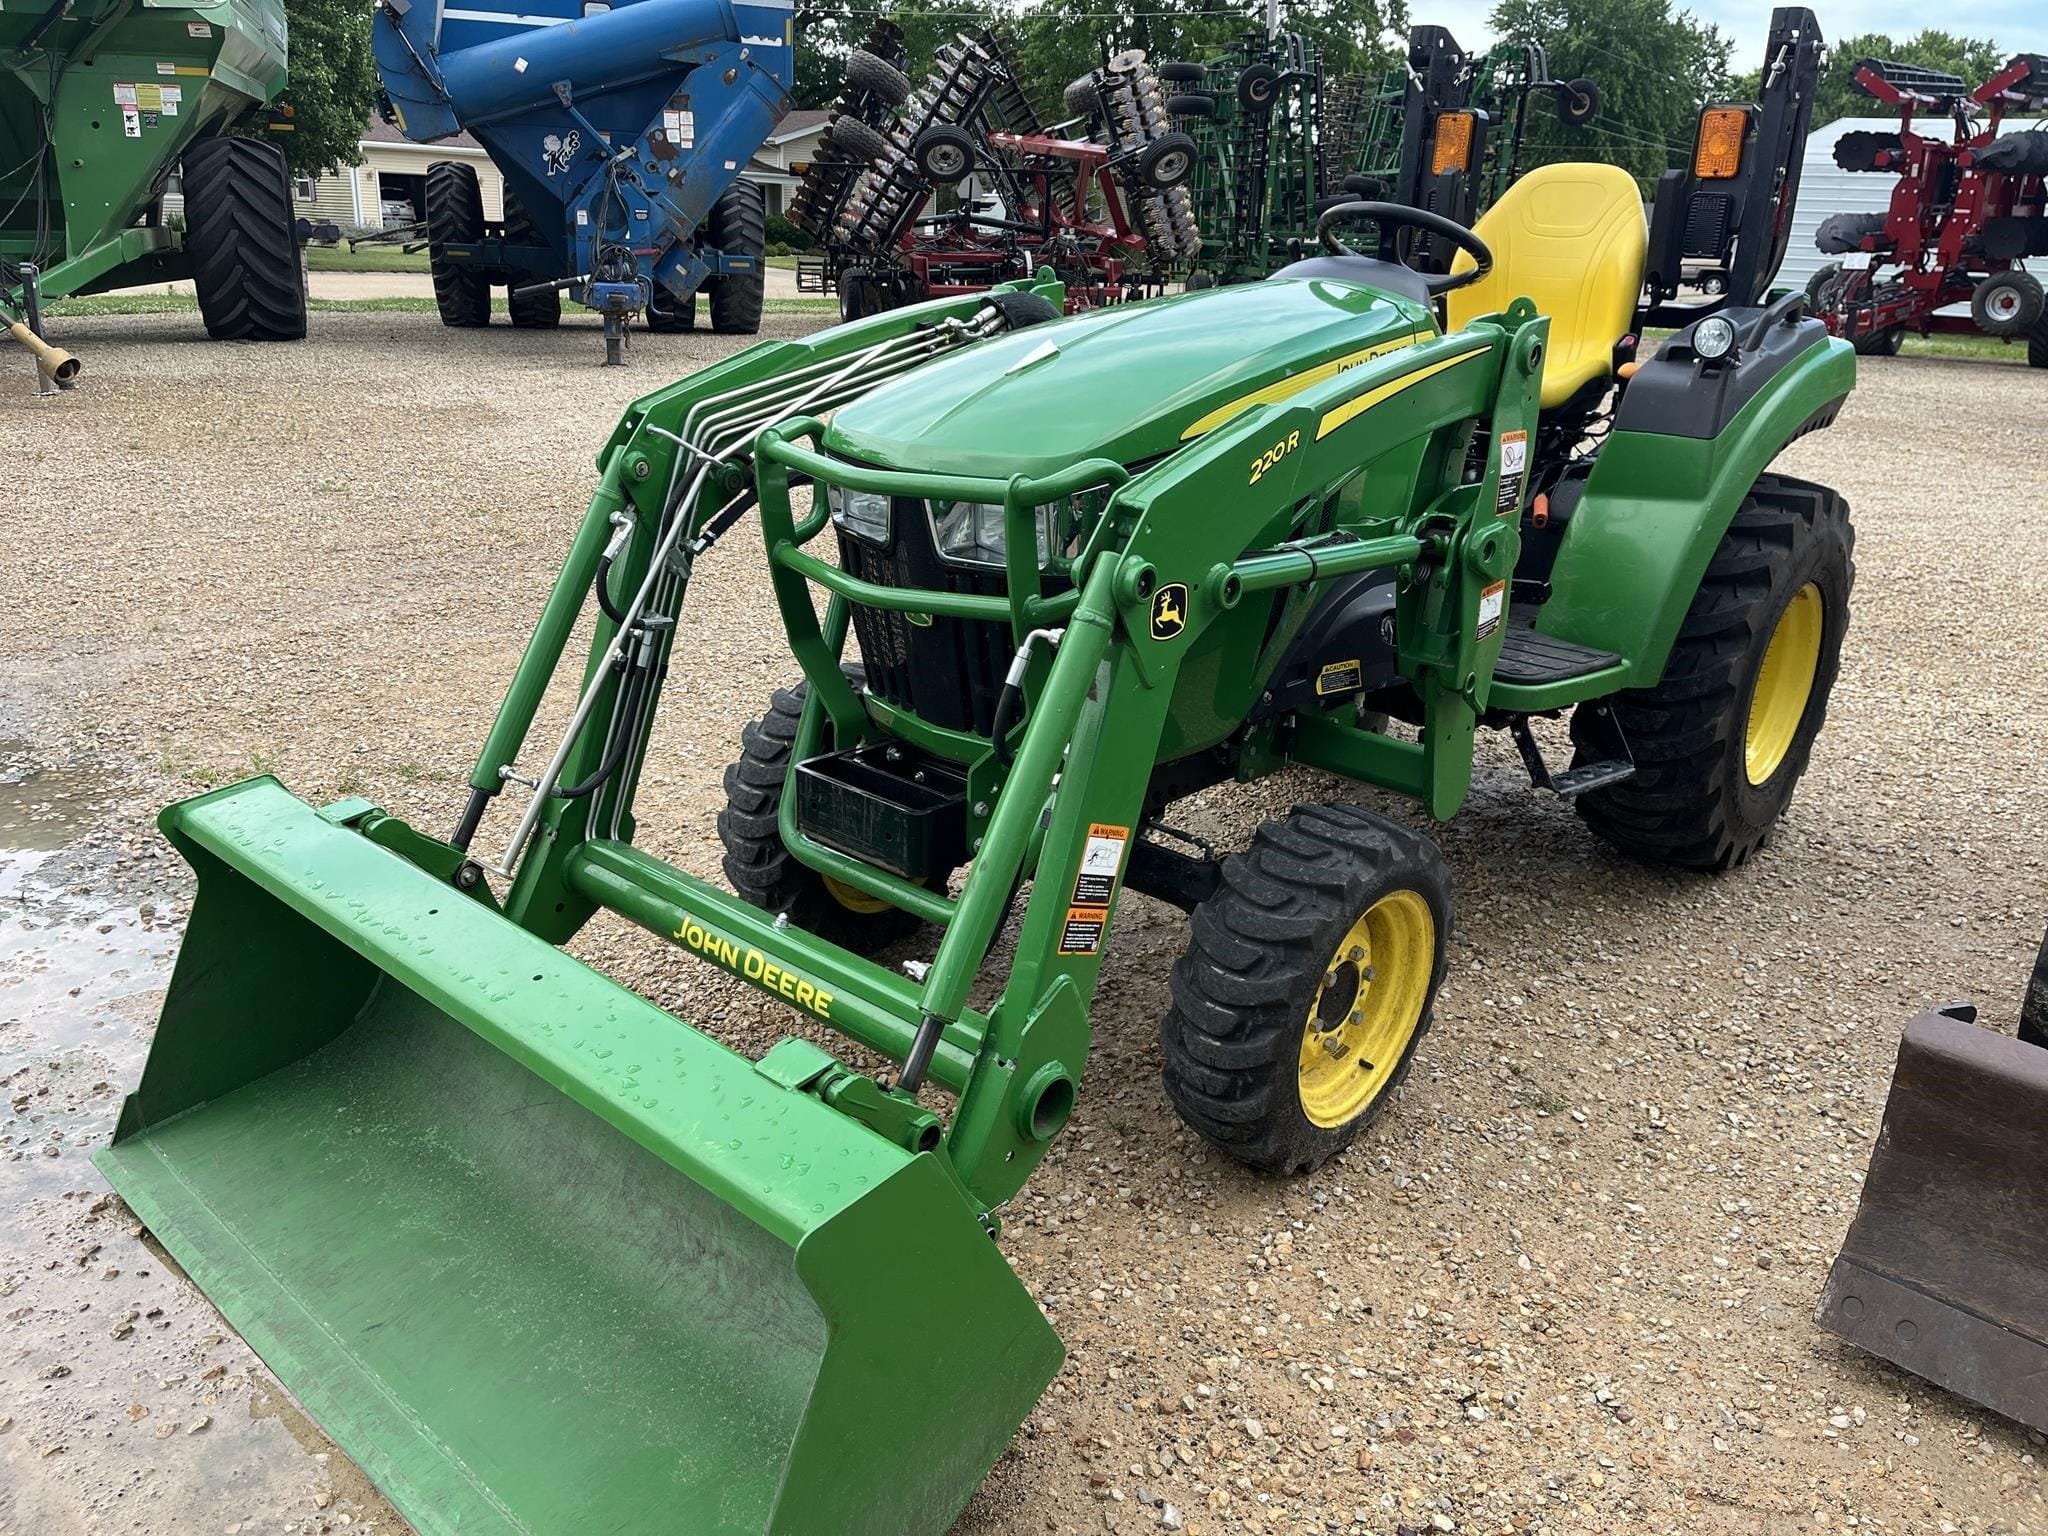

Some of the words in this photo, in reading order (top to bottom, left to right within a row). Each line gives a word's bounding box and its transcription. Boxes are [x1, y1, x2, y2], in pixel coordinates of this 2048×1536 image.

[1329, 661, 1354, 671] CAUTION
[1100, 828, 1124, 837] WARNING
[1078, 912, 1103, 920] WARNING
[673, 916, 740, 968] JOHN
[743, 948, 834, 1018] DEERE
